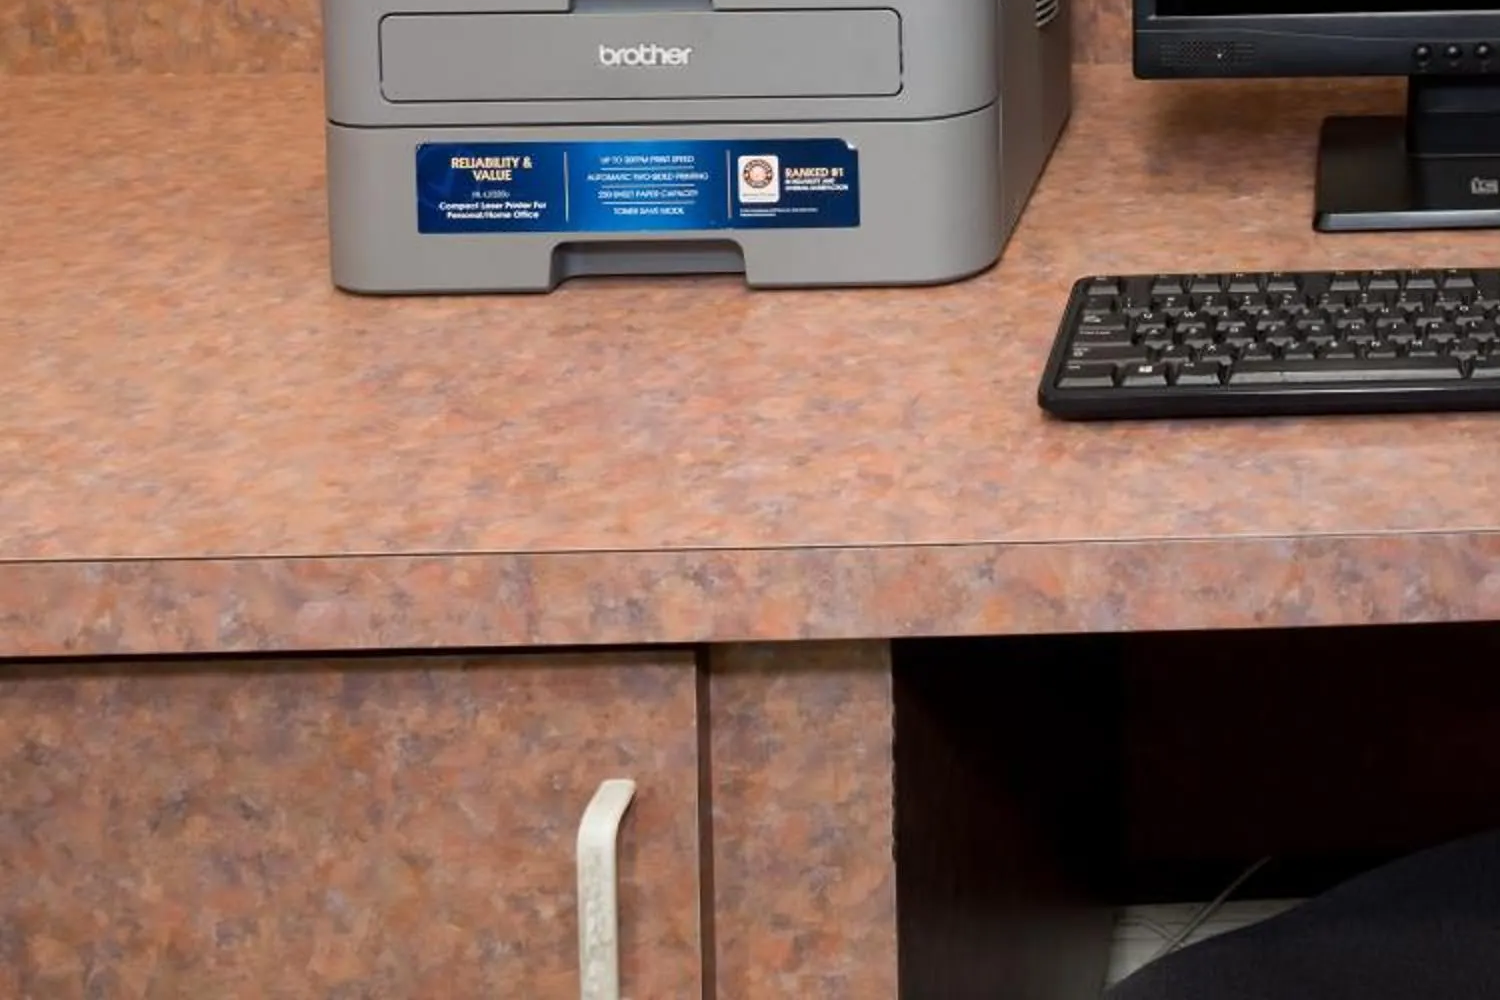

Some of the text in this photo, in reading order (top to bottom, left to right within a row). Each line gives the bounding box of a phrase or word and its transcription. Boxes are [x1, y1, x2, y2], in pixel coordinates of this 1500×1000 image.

[598, 43, 692, 65] brother
[451, 156, 533, 169] RELIABILITY &
[472, 170, 513, 181] VALUE
[784, 167, 829, 178] RANKED
[438, 201, 479, 211] Compact
[513, 210, 539, 219] Office
